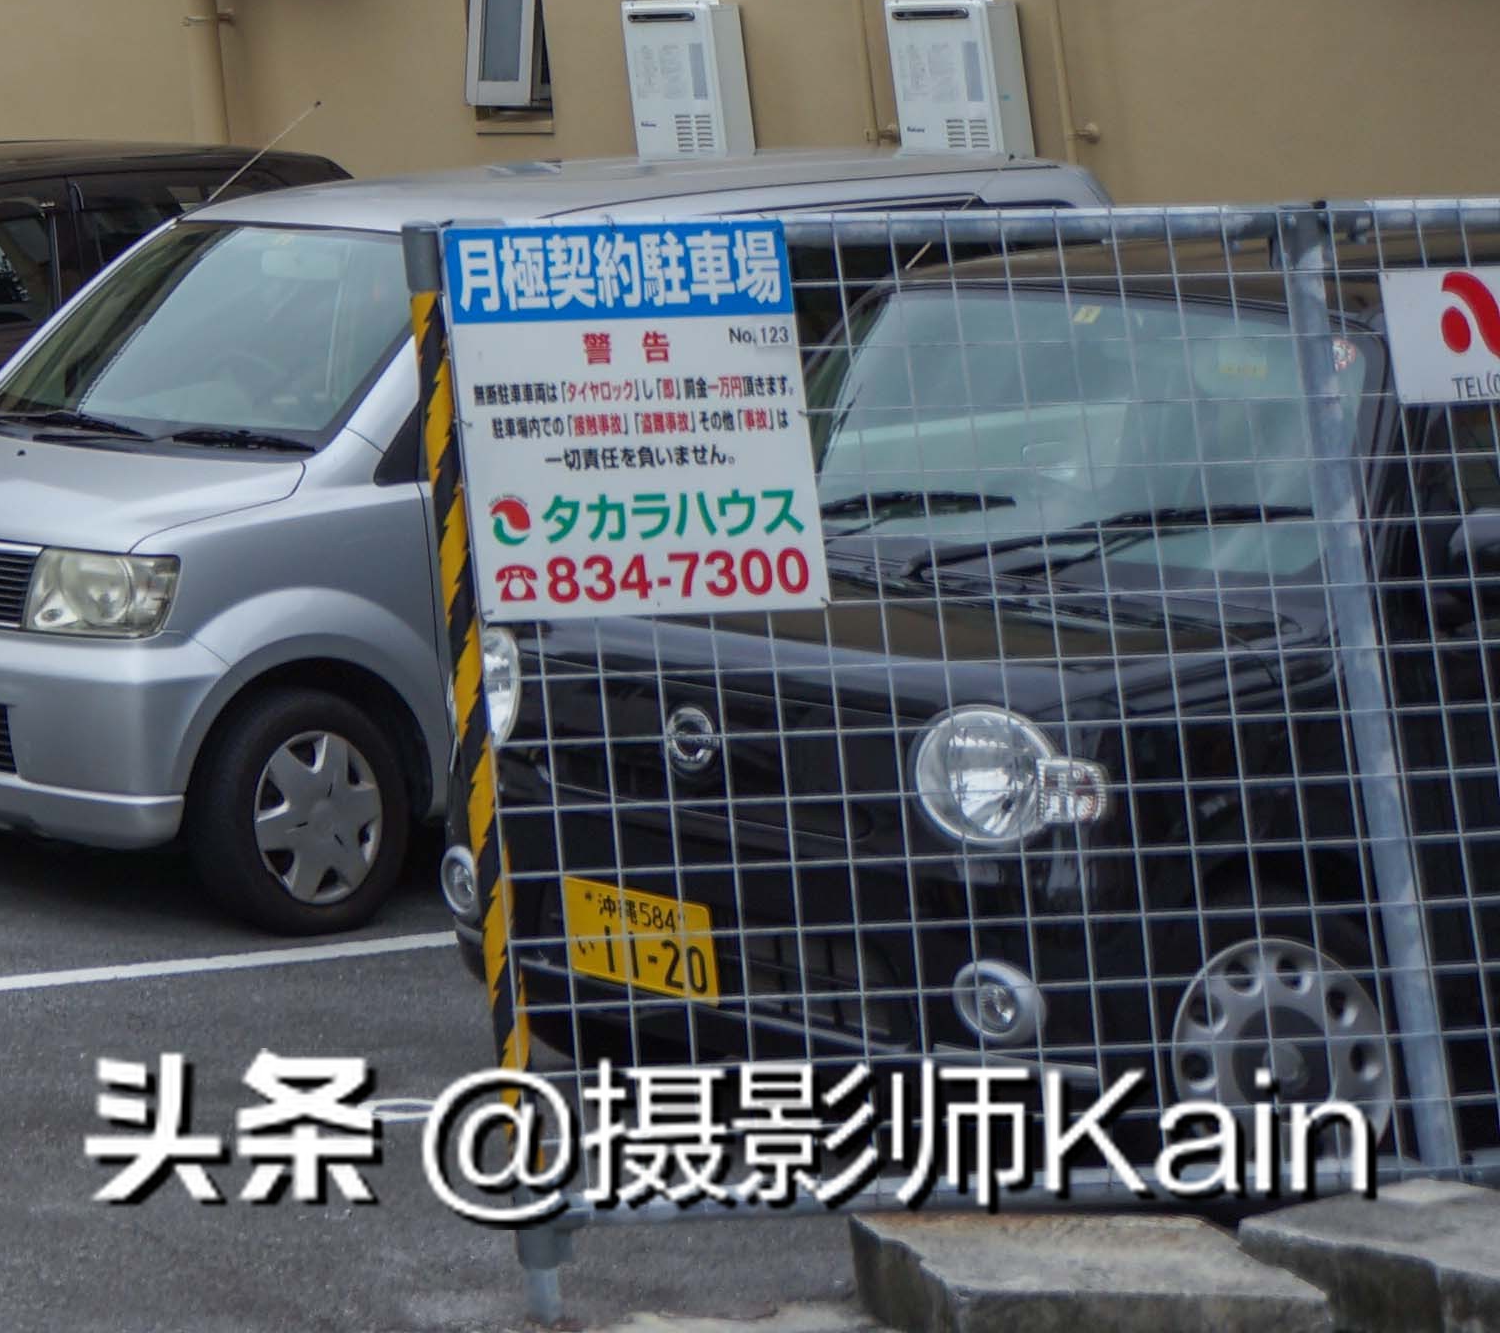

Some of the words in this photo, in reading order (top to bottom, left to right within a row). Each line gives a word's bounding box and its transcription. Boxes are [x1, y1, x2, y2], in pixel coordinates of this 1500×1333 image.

[458, 230, 782, 314] 月極契約駐車場
[545, 443, 736, 471] 一切責任を負いません。
[542, 488, 805, 544] タカラハウス
[547, 547, 810, 604] 834-7300
[604, 925, 708, 995] 11-20
